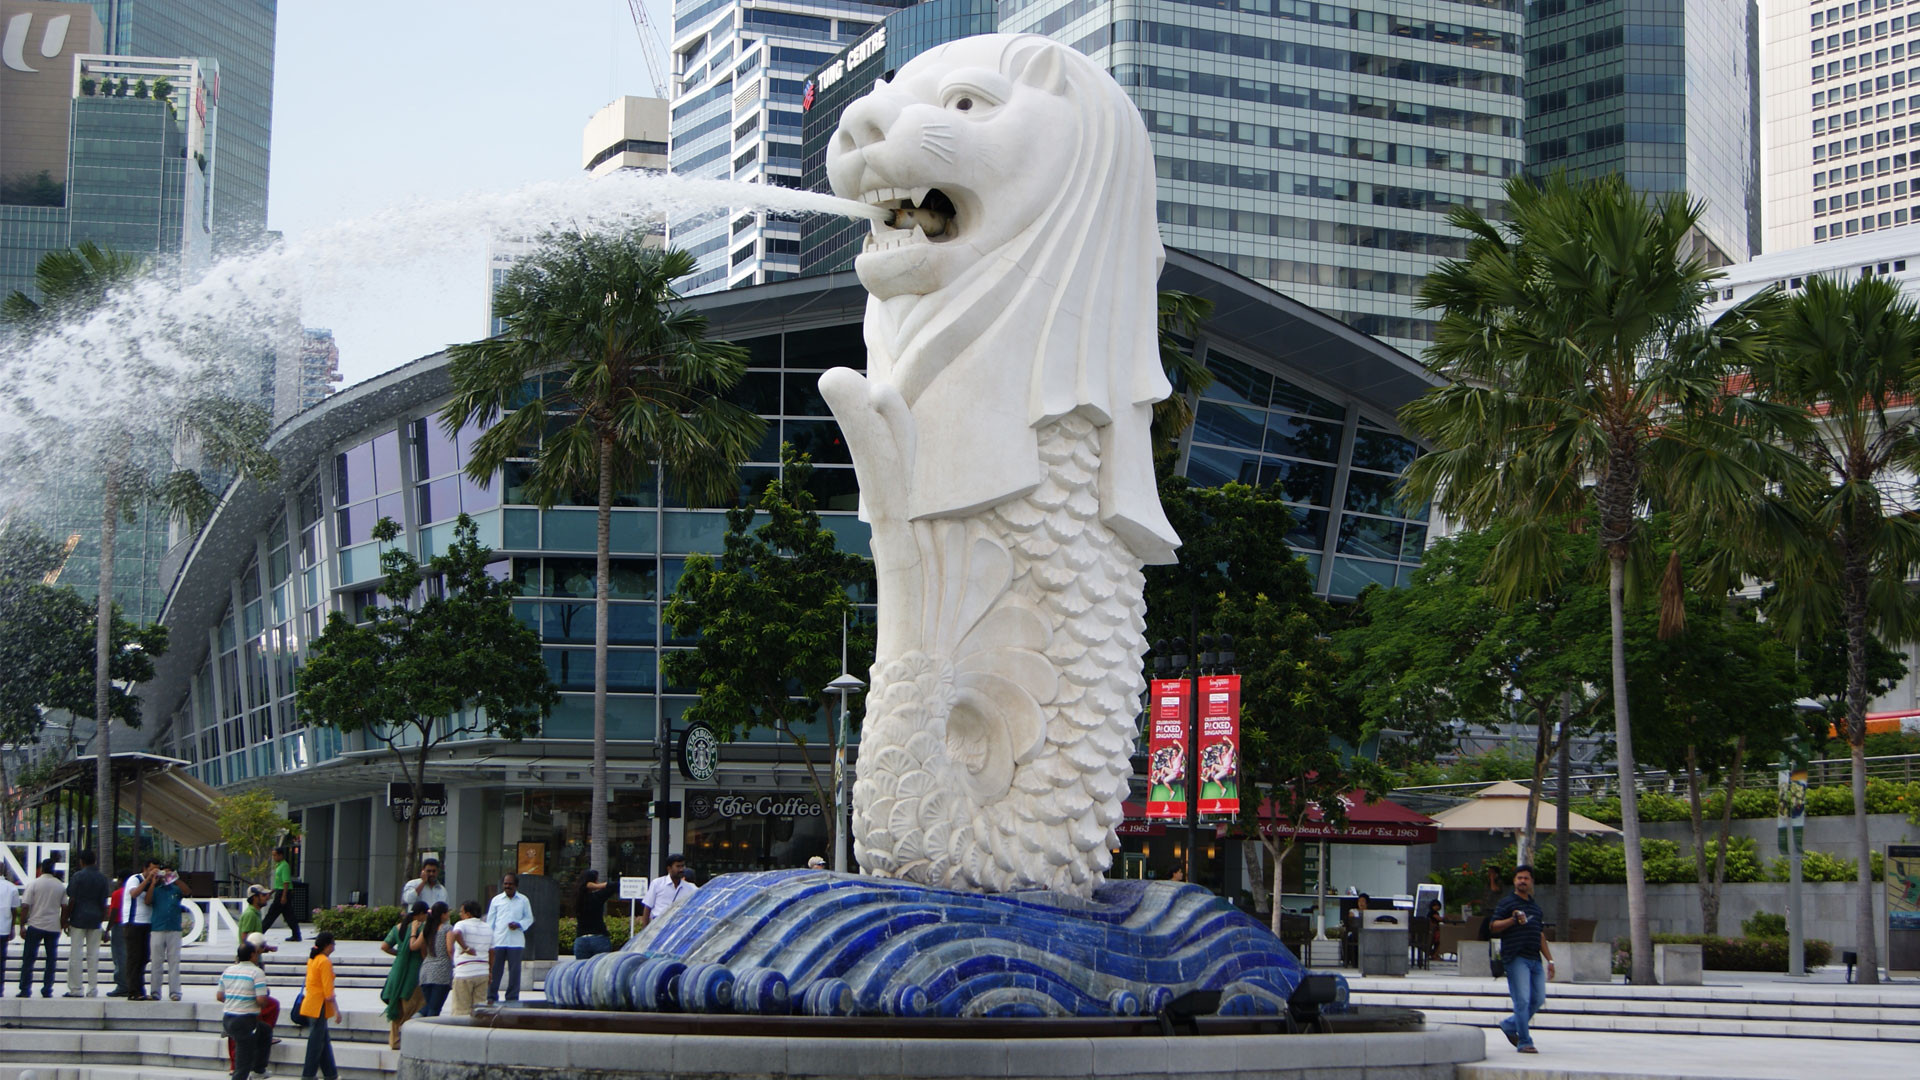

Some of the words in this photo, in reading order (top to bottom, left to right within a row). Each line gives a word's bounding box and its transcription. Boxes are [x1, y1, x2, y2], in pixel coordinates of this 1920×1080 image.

[817, 59, 845, 93] TUNG
[846, 26, 887, 72] CENTRE
[687, 730, 717, 753] STARBUCKS
[691, 763, 712, 778] COFFEE
[715, 795, 753, 817] The
[756, 796, 821, 816] Coffee
[1129, 824, 1150, 833] 1963
[1322, 825, 1331, 834] &
[1349, 826, 1373, 836] Leaf
[1396, 828, 1419, 837] 1963
